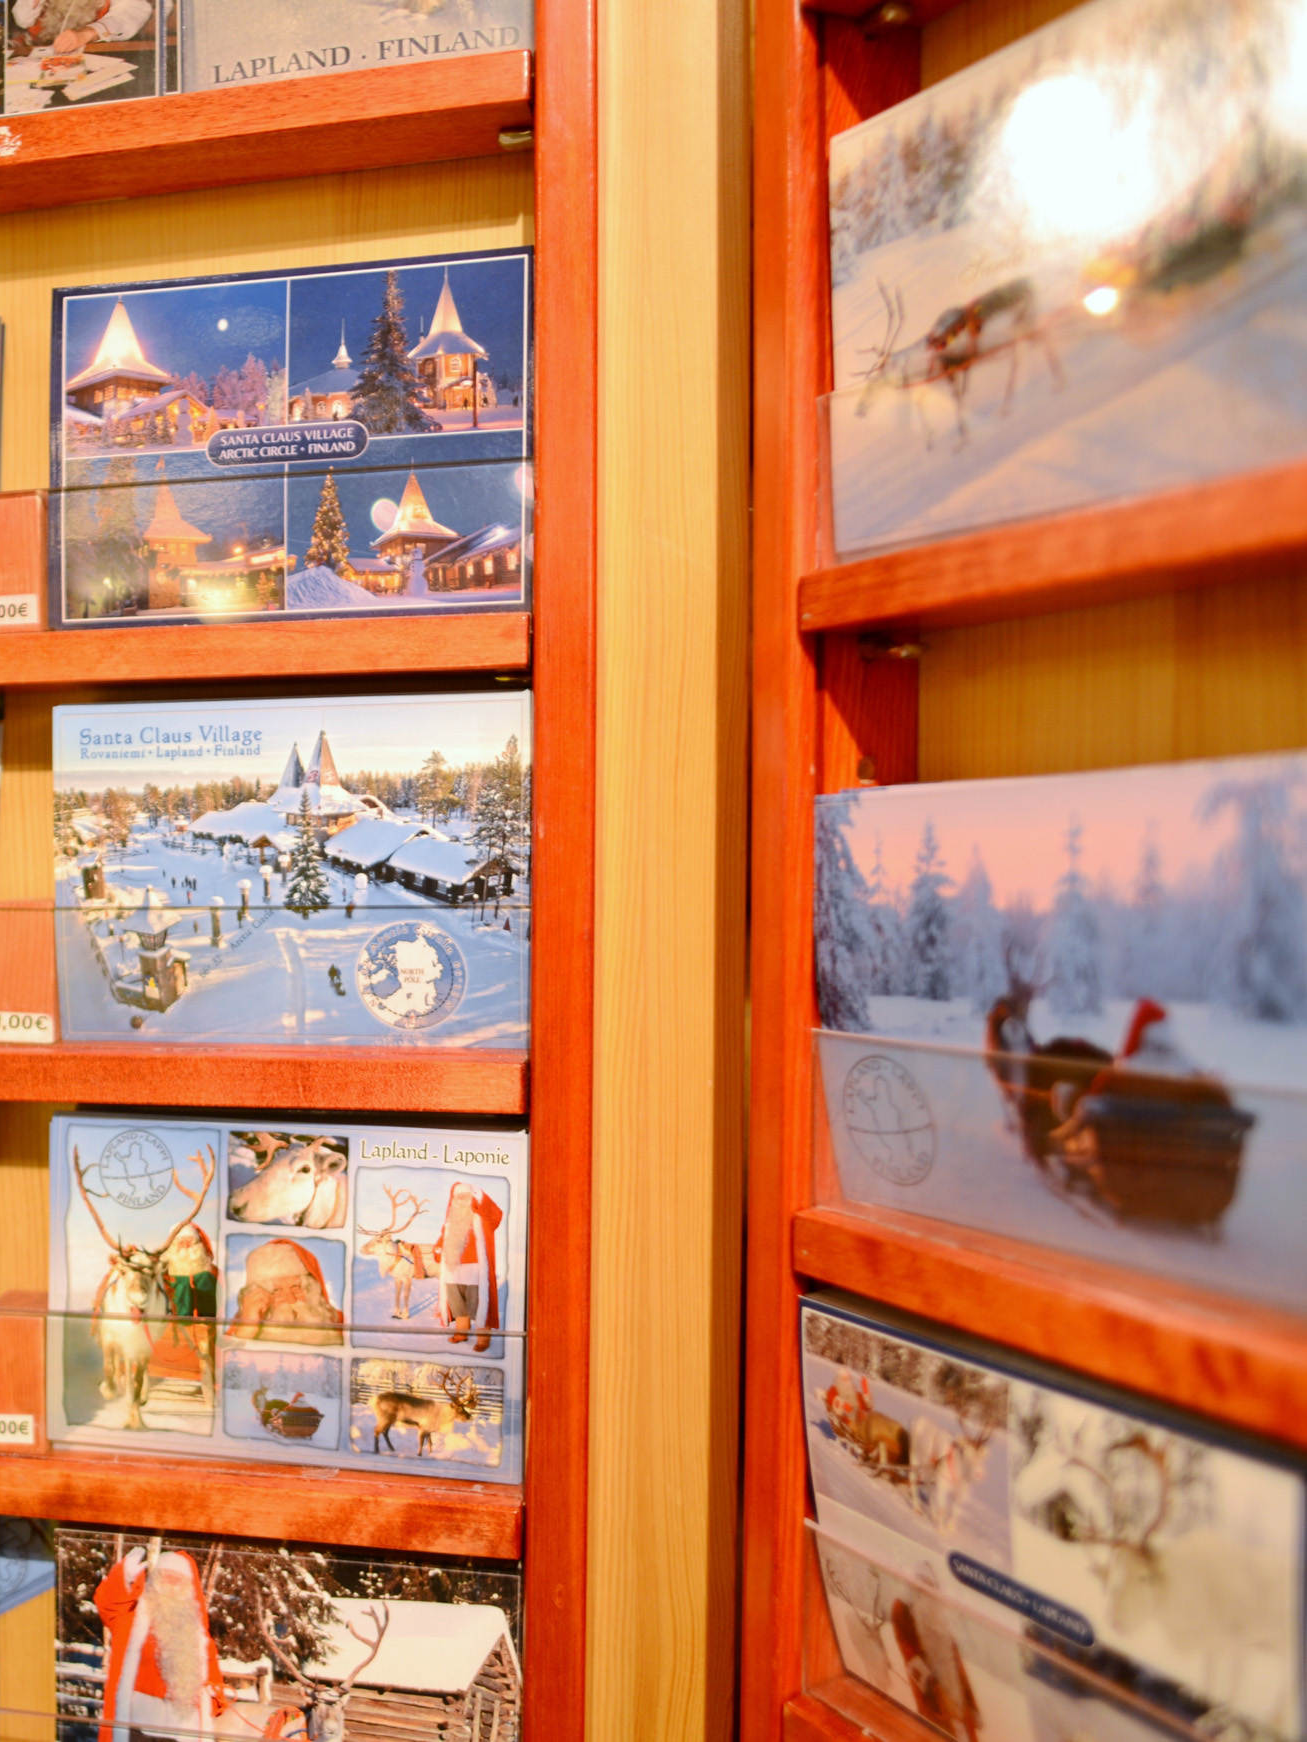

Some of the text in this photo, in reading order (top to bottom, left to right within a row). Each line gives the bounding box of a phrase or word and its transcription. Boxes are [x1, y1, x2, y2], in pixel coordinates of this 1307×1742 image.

[213, 26, 521, 84] LAPLAND FINLAND
[220, 427, 354, 447] SANTA CLAUS VILLAGE
[219, 441, 356, 460] ARCTIC CIRCLE FINLAND
[79, 725, 263, 746] Santa Claus Village
[80, 744, 261, 761] Rovaniemi Lapland Finland
[403, 976, 421, 984] POLE
[360, 1139, 510, 1167] Lapland Laponie
[117, 1184, 166, 1207] FINLAND
